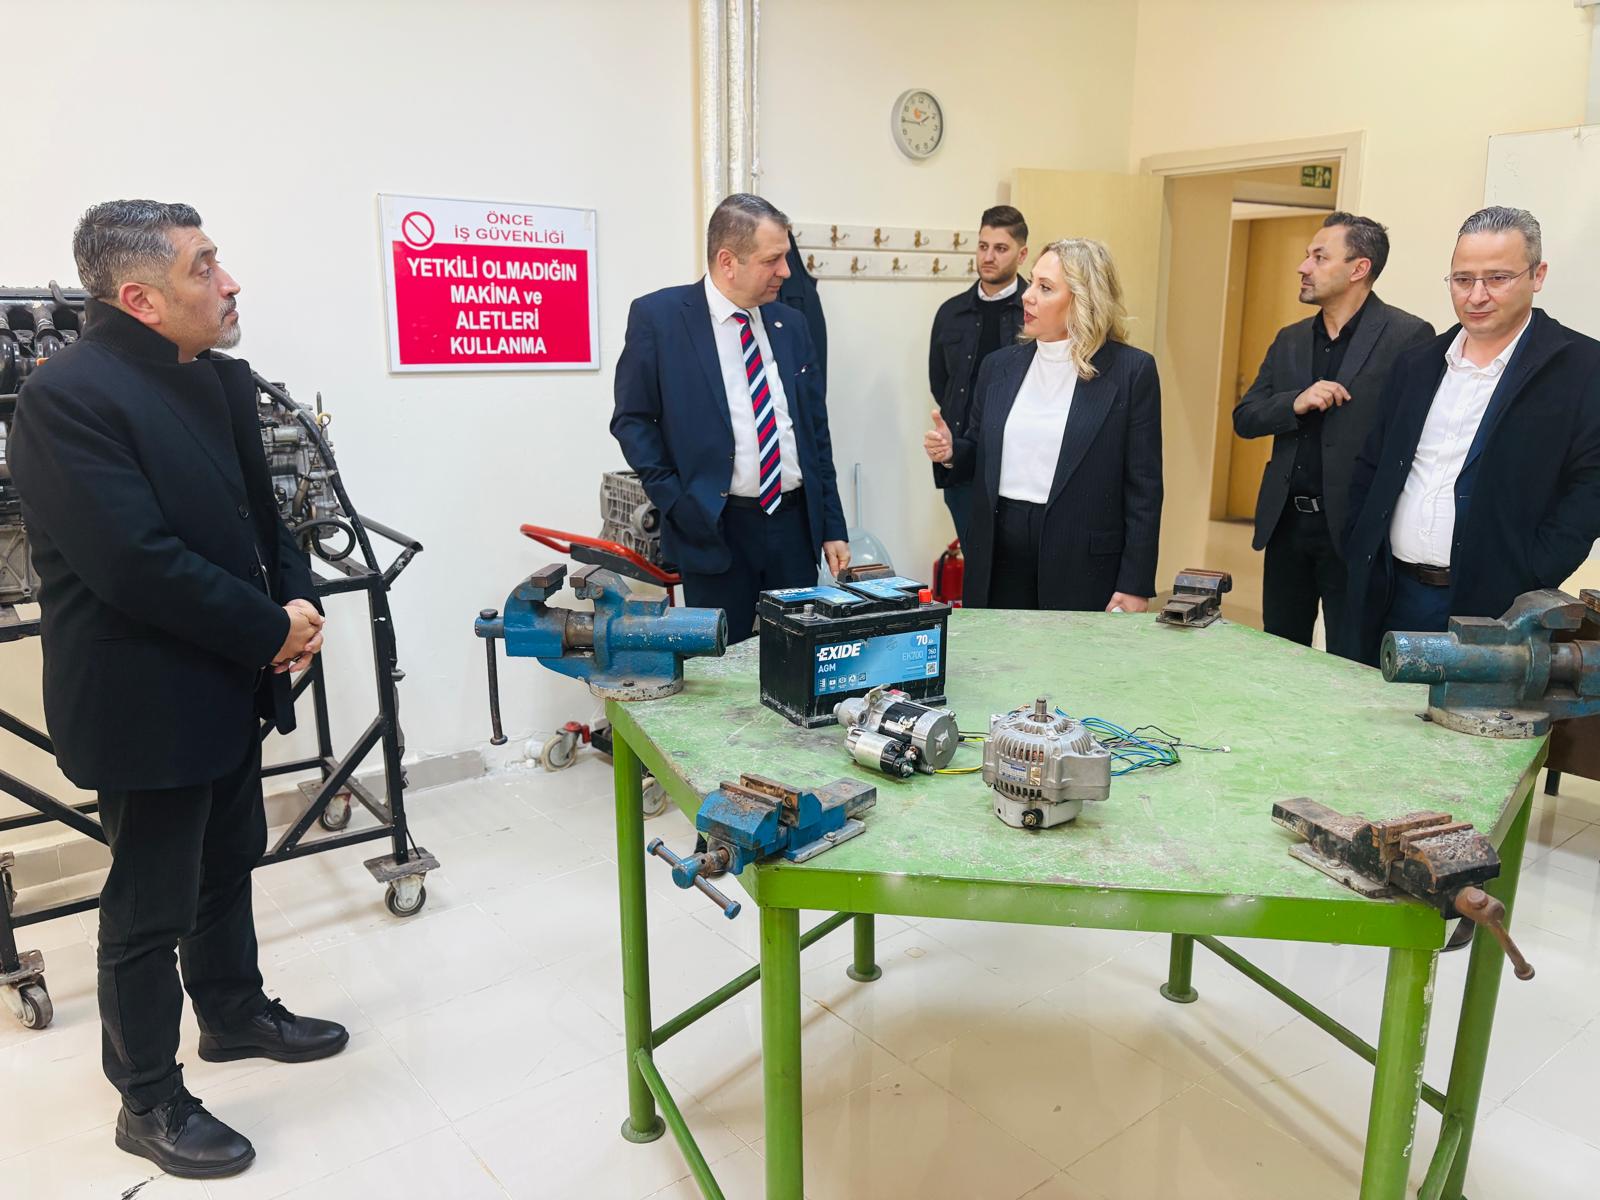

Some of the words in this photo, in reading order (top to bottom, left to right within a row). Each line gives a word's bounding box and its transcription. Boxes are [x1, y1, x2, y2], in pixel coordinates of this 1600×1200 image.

[486, 210, 534, 227] ÖNCE
[454, 224, 471, 242] İŞ
[475, 228, 565, 245] GÜVENLİĞİ
[406, 255, 478, 279] YETKİLİ
[482, 259, 578, 282] OLMADIĞIN
[450, 281, 521, 304] MAKİNA
[523, 290, 543, 305] ve
[455, 308, 540, 331] ALETLERİ
[449, 336, 548, 355] KULLANMA
[916, 634, 928, 646] 70
[816, 642, 862, 662] EXIDE
[817, 662, 836, 673] AGM
